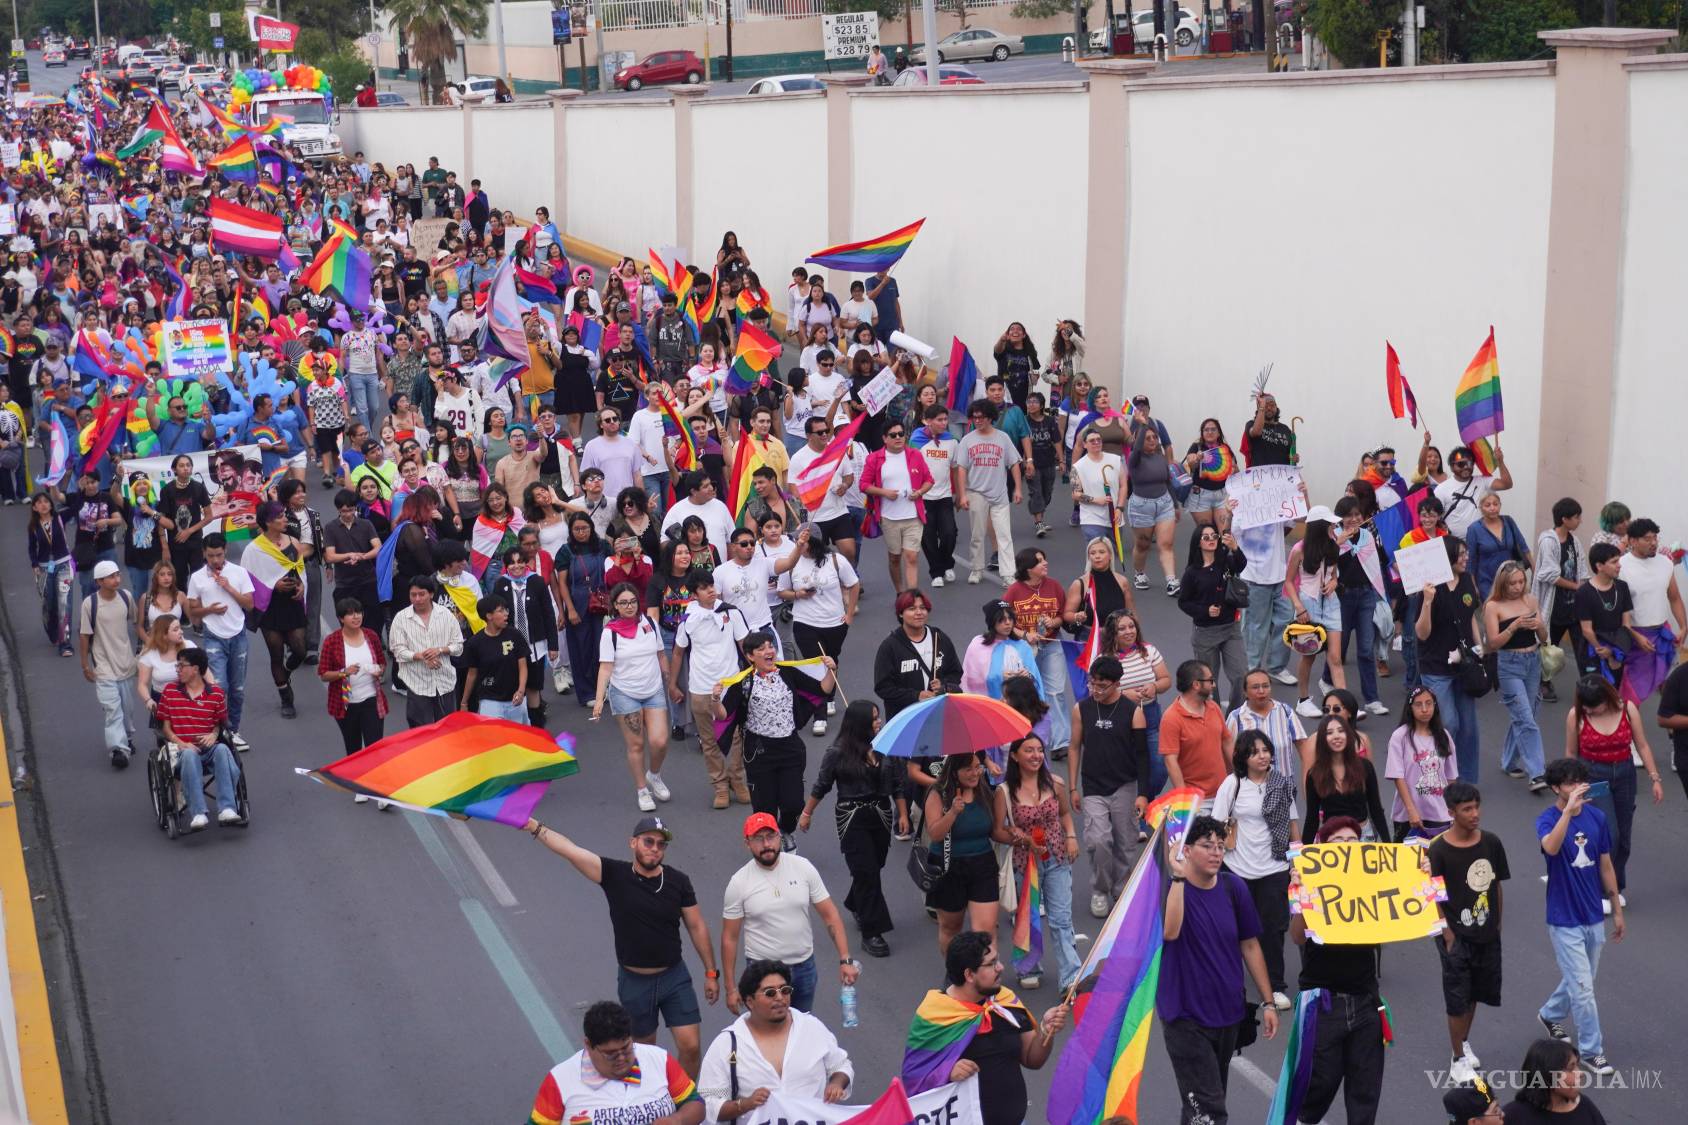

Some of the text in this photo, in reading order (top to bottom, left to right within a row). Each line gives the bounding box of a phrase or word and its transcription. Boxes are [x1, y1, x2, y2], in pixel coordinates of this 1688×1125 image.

[836, 14, 865, 24] REGULAR
[838, 35, 867, 45] PREMIUM
[447, 409, 467, 430] 29
[973, 457, 1000, 468] COLLEGE
[1300, 844, 1423, 875] SOY GAY Y
[1318, 884, 1423, 926] PUNTO
